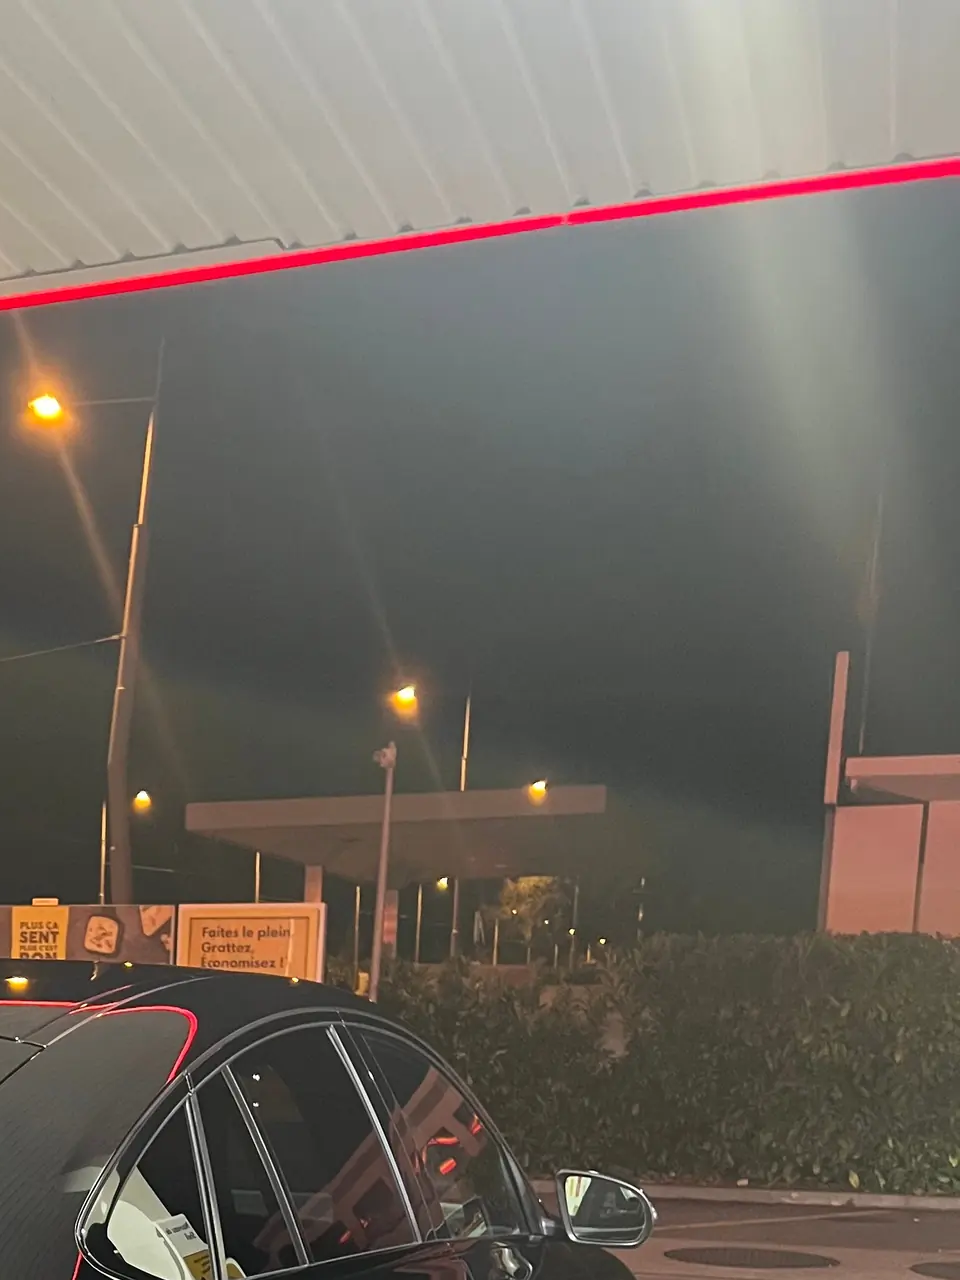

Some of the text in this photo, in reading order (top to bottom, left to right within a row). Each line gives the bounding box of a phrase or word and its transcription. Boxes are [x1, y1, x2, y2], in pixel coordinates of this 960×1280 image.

[19, 931, 59, 944] SENT
[202, 926, 239, 938] Faites
[242, 926, 254, 938] le
[201, 953, 276, 968] Économisez
